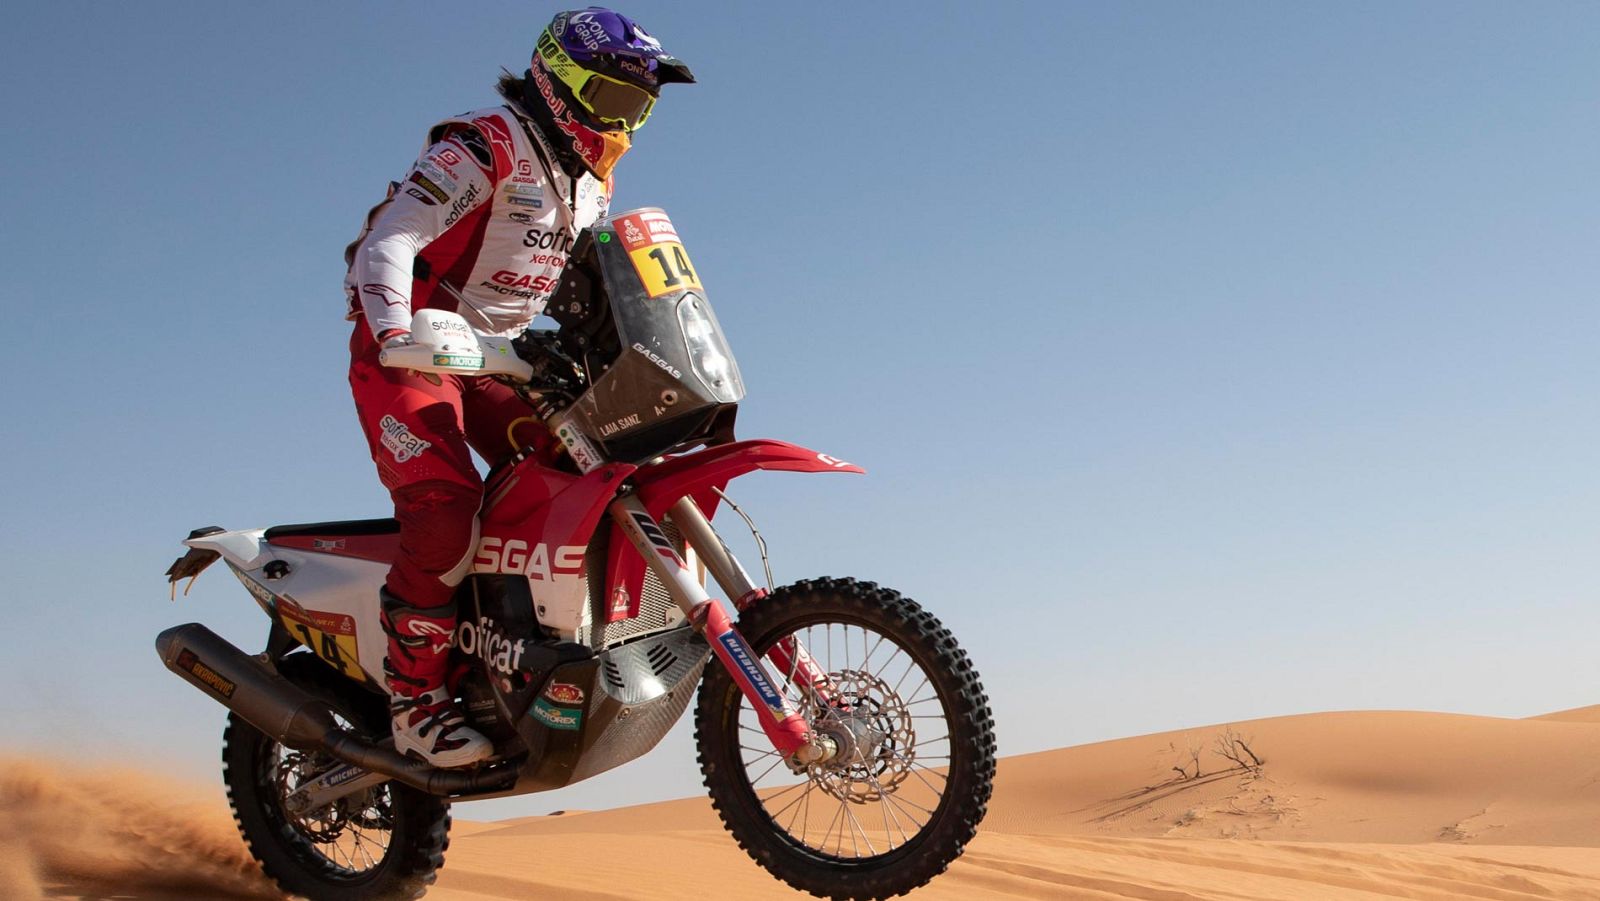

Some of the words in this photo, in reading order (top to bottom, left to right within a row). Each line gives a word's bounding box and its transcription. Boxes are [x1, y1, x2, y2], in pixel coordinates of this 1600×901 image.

[575, 24, 598, 50] GRUP
[621, 61, 644, 76] PONT
[648, 246, 695, 288] 14
[480, 281, 541, 301] FACTORY
[632, 342, 682, 380] GASGAS
[600, 420, 620, 437] LAIA
[618, 413, 642, 431] SANZ
[296, 623, 349, 673] 14
[726, 638, 777, 699] MICHELIN
[534, 705, 576, 725] MOTOREX
